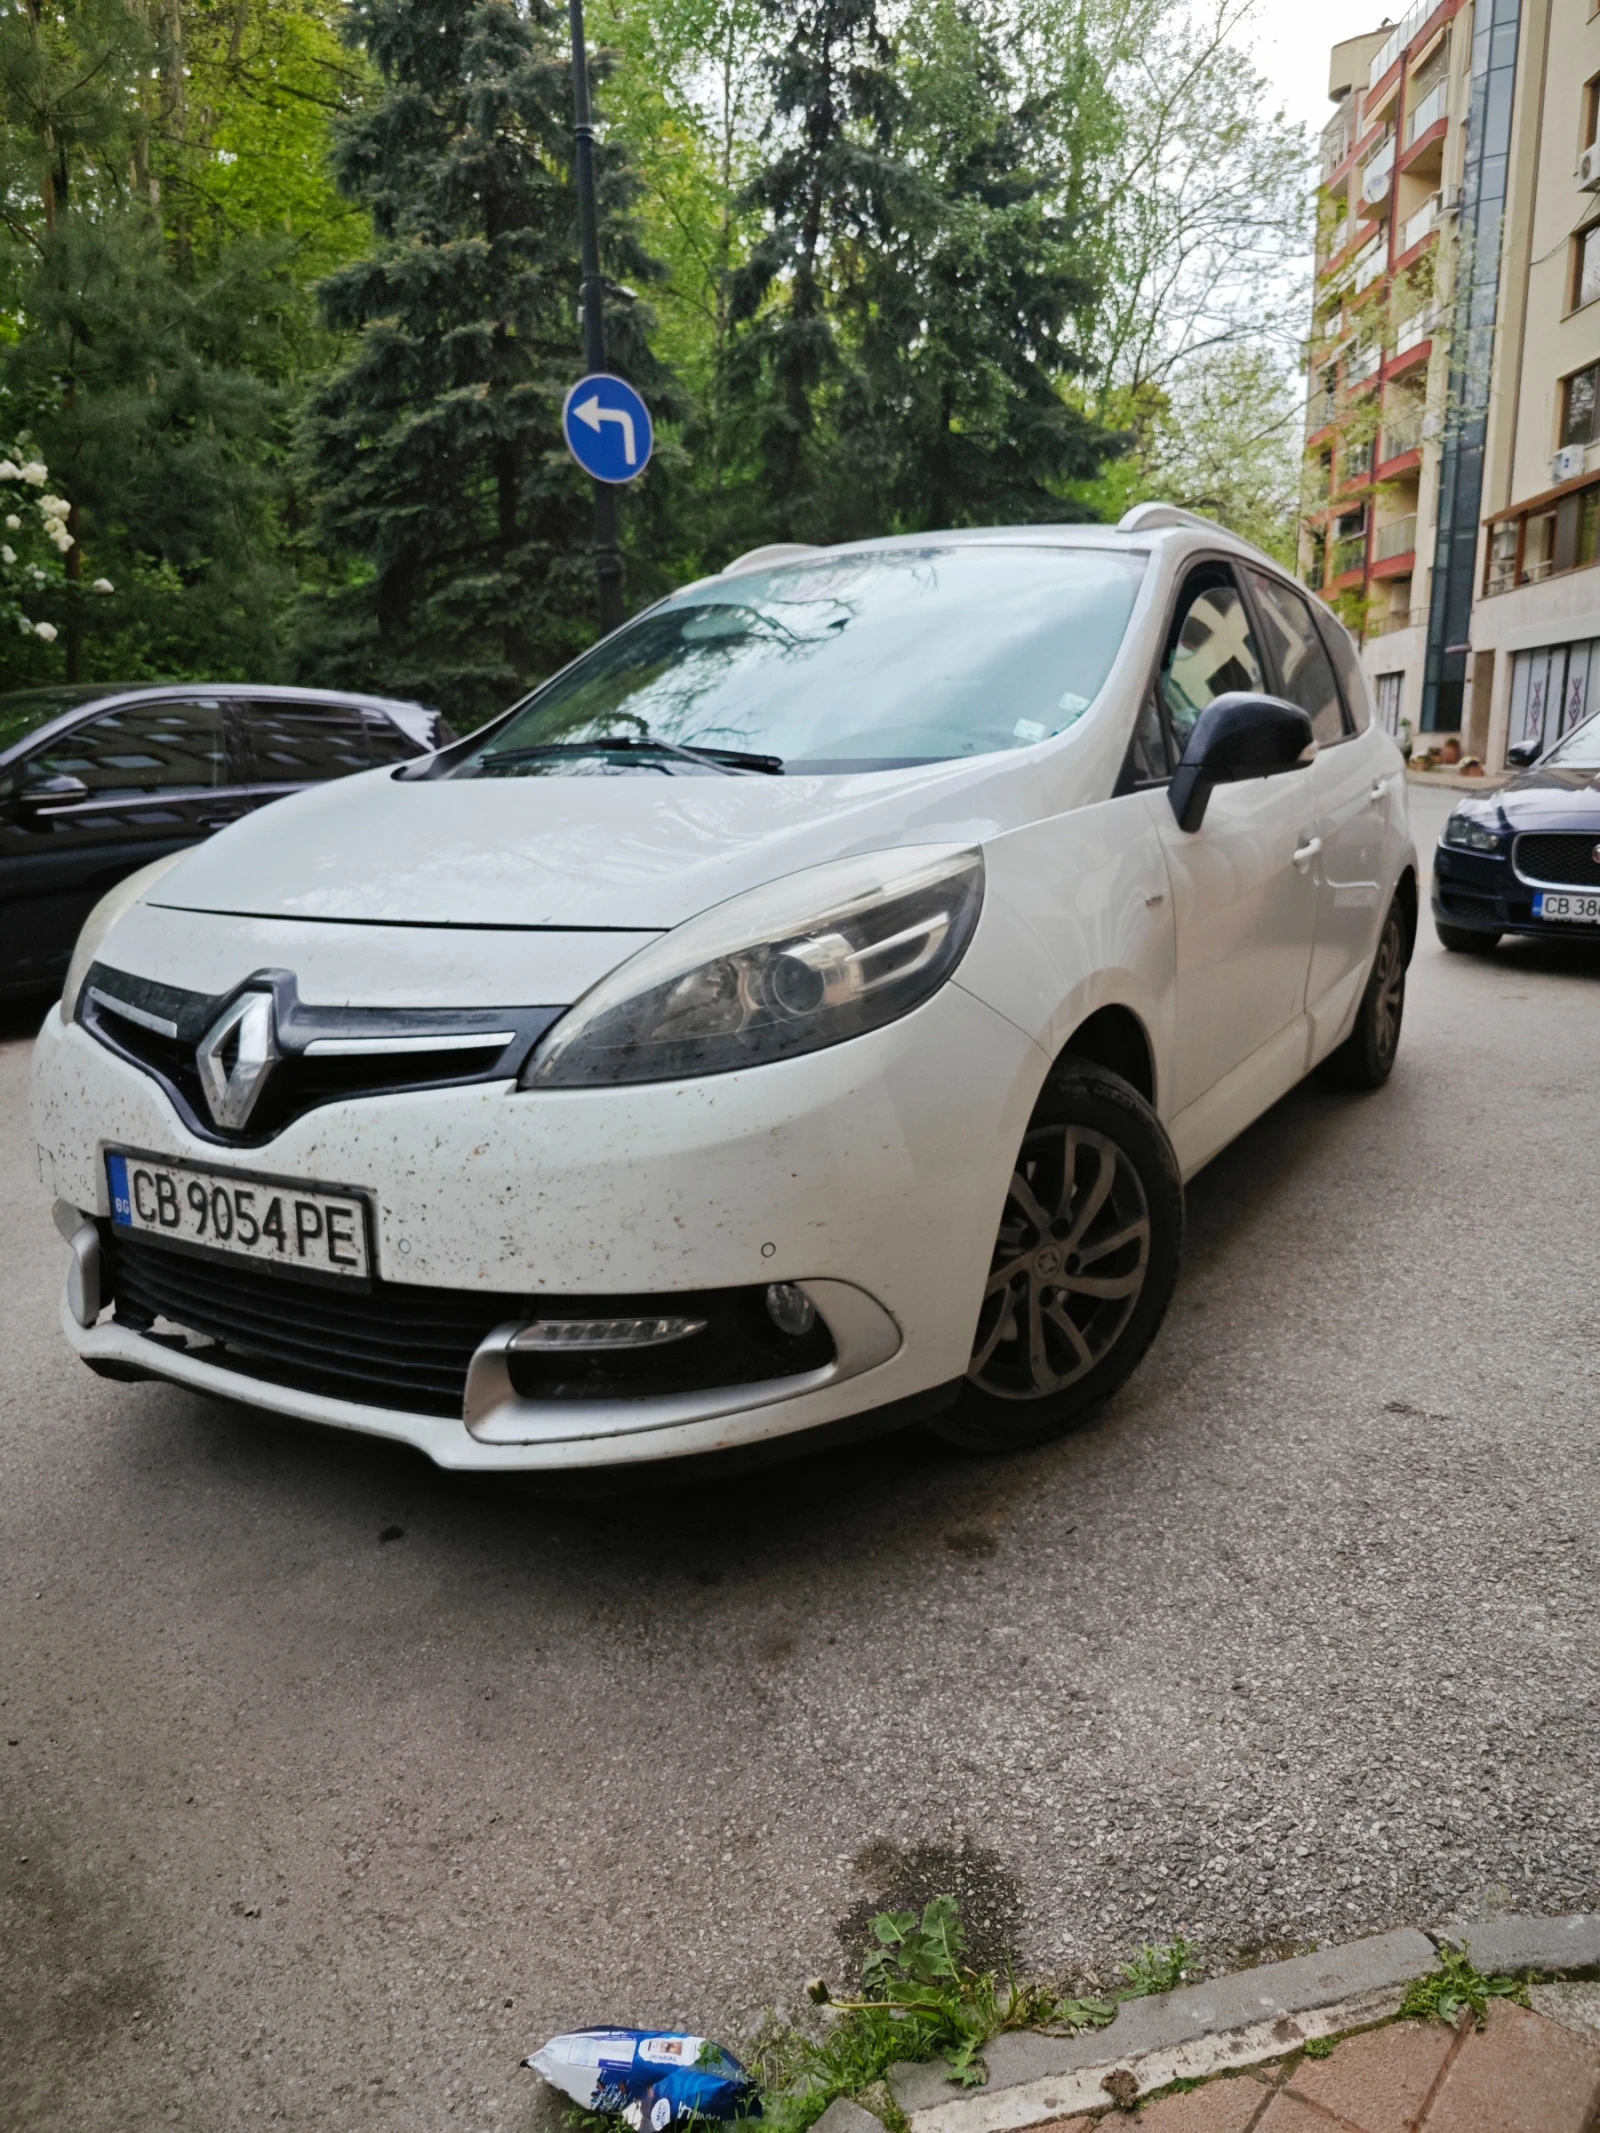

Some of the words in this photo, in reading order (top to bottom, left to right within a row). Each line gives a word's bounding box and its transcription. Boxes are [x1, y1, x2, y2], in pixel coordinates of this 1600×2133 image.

[1545, 897, 1569, 915] CB
[1573, 899, 1600, 917] 38
[115, 1197, 130, 1215] BG
[133, 1169, 181, 1229] CB
[187, 1179, 287, 1252] 9054
[295, 1200, 358, 1267] PE
